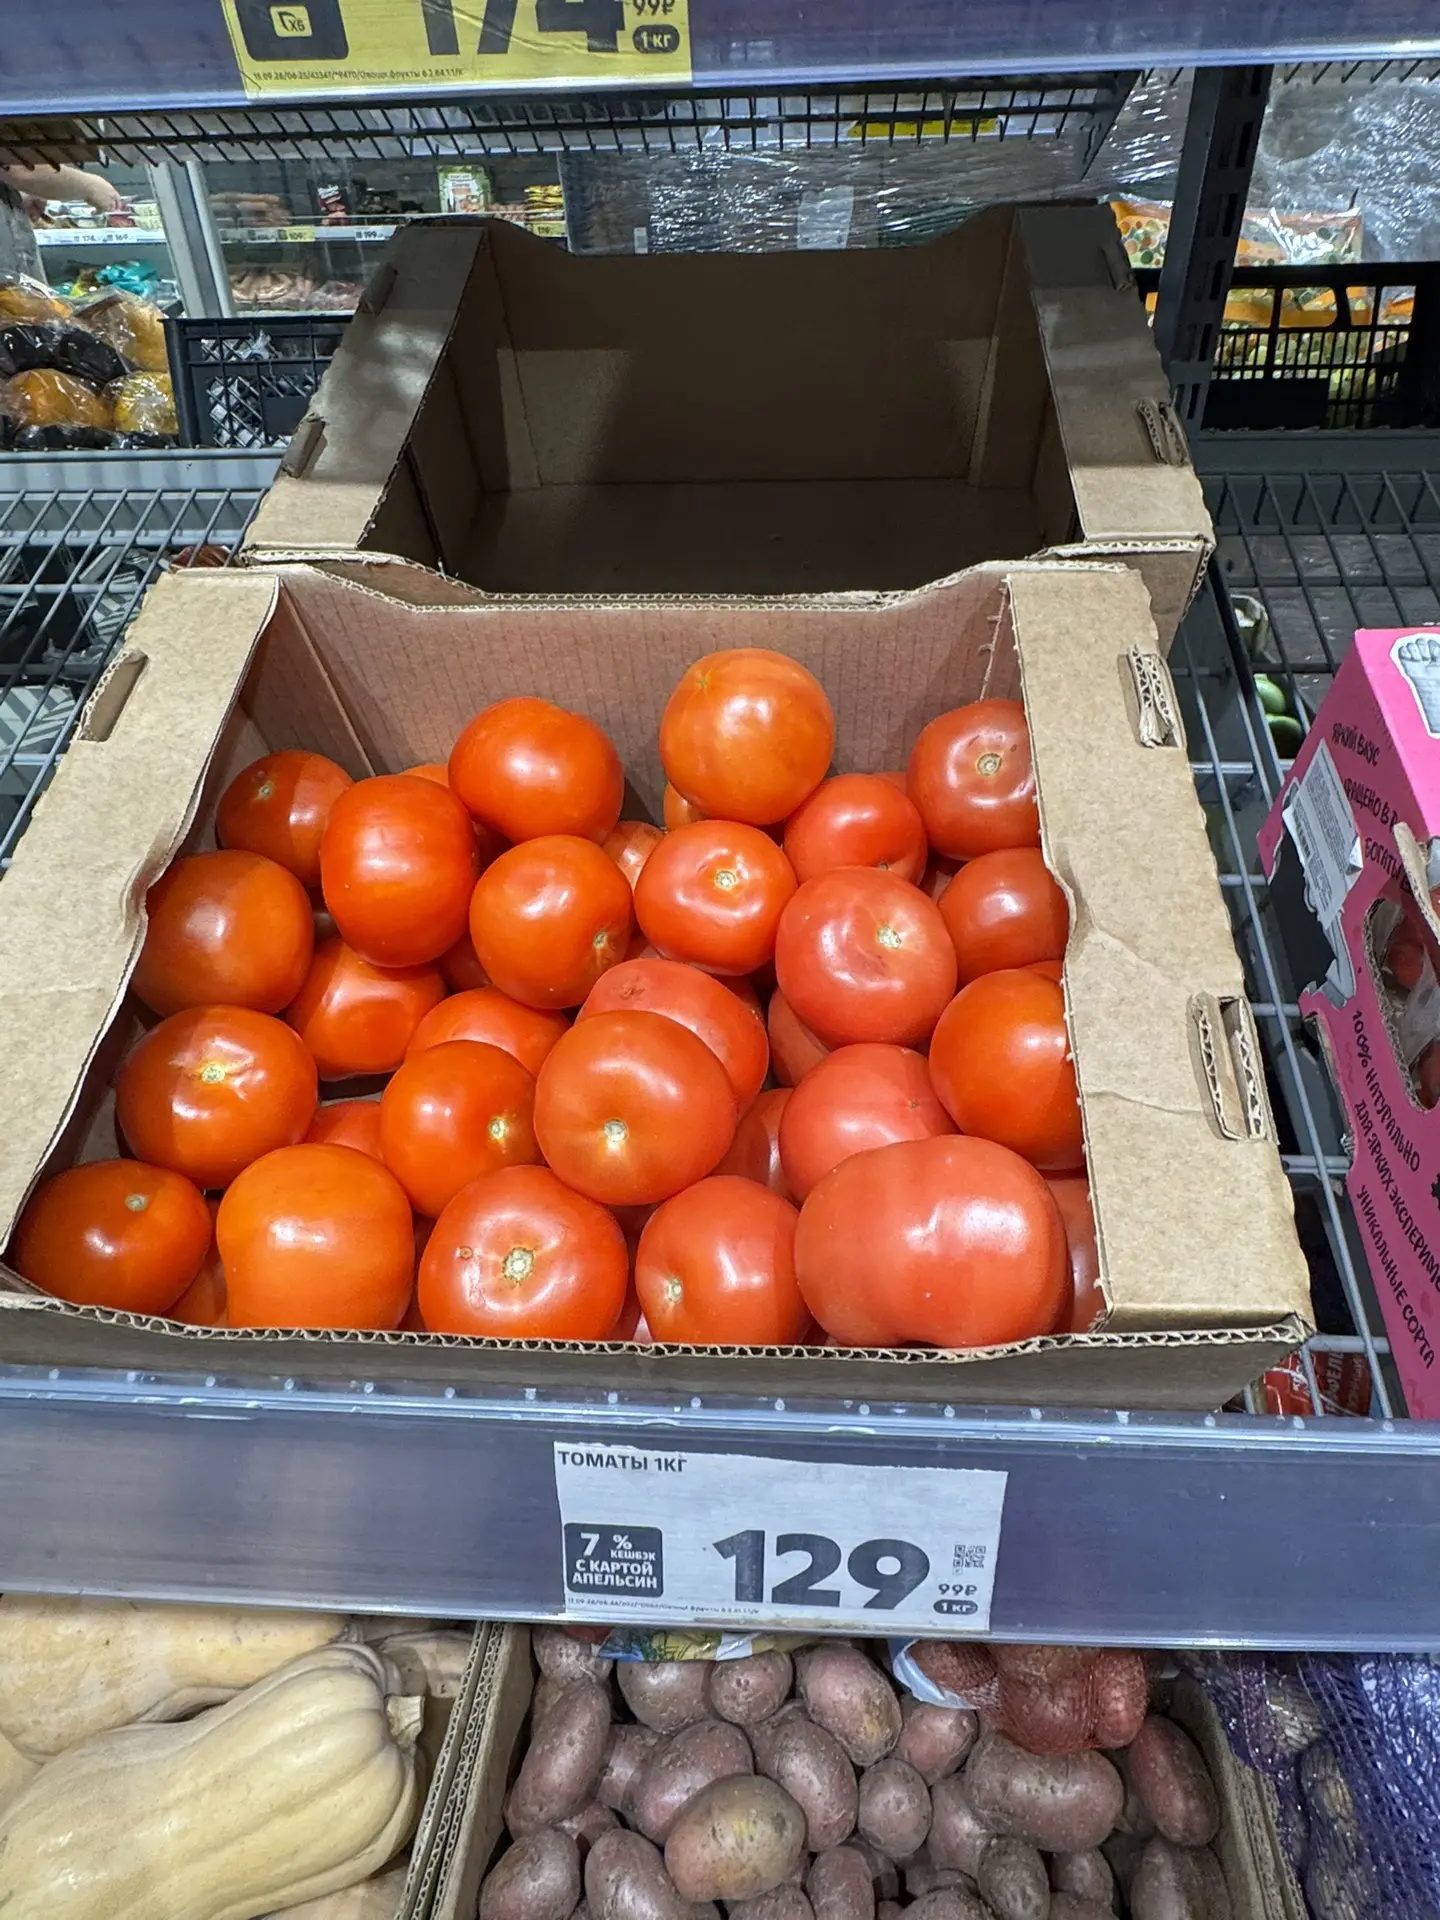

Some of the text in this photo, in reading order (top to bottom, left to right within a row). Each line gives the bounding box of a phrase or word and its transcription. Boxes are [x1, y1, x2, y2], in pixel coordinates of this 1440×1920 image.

[1353, 1010, 1420, 1172] 100% НАТУРАЛЬНО
[1355, 1100, 1374, 1137] ДЛЯ
[1368, 1133, 1394, 1192] ЯРКИХ
[1357, 1185, 1435, 1369] УНИКАЛЬНЫЕ СОРТА
[557, 1450, 687, 1474] ТОМАТЫ 1КГ
[580, 1532, 600, 1556] 7
[610, 1549, 656, 1561] КЕШБЭК
[589, 1559, 653, 1576] КАРТОЙ
[712, 1529, 931, 1610] 129
[572, 1572, 658, 1588] АПЕЛЬСИН
